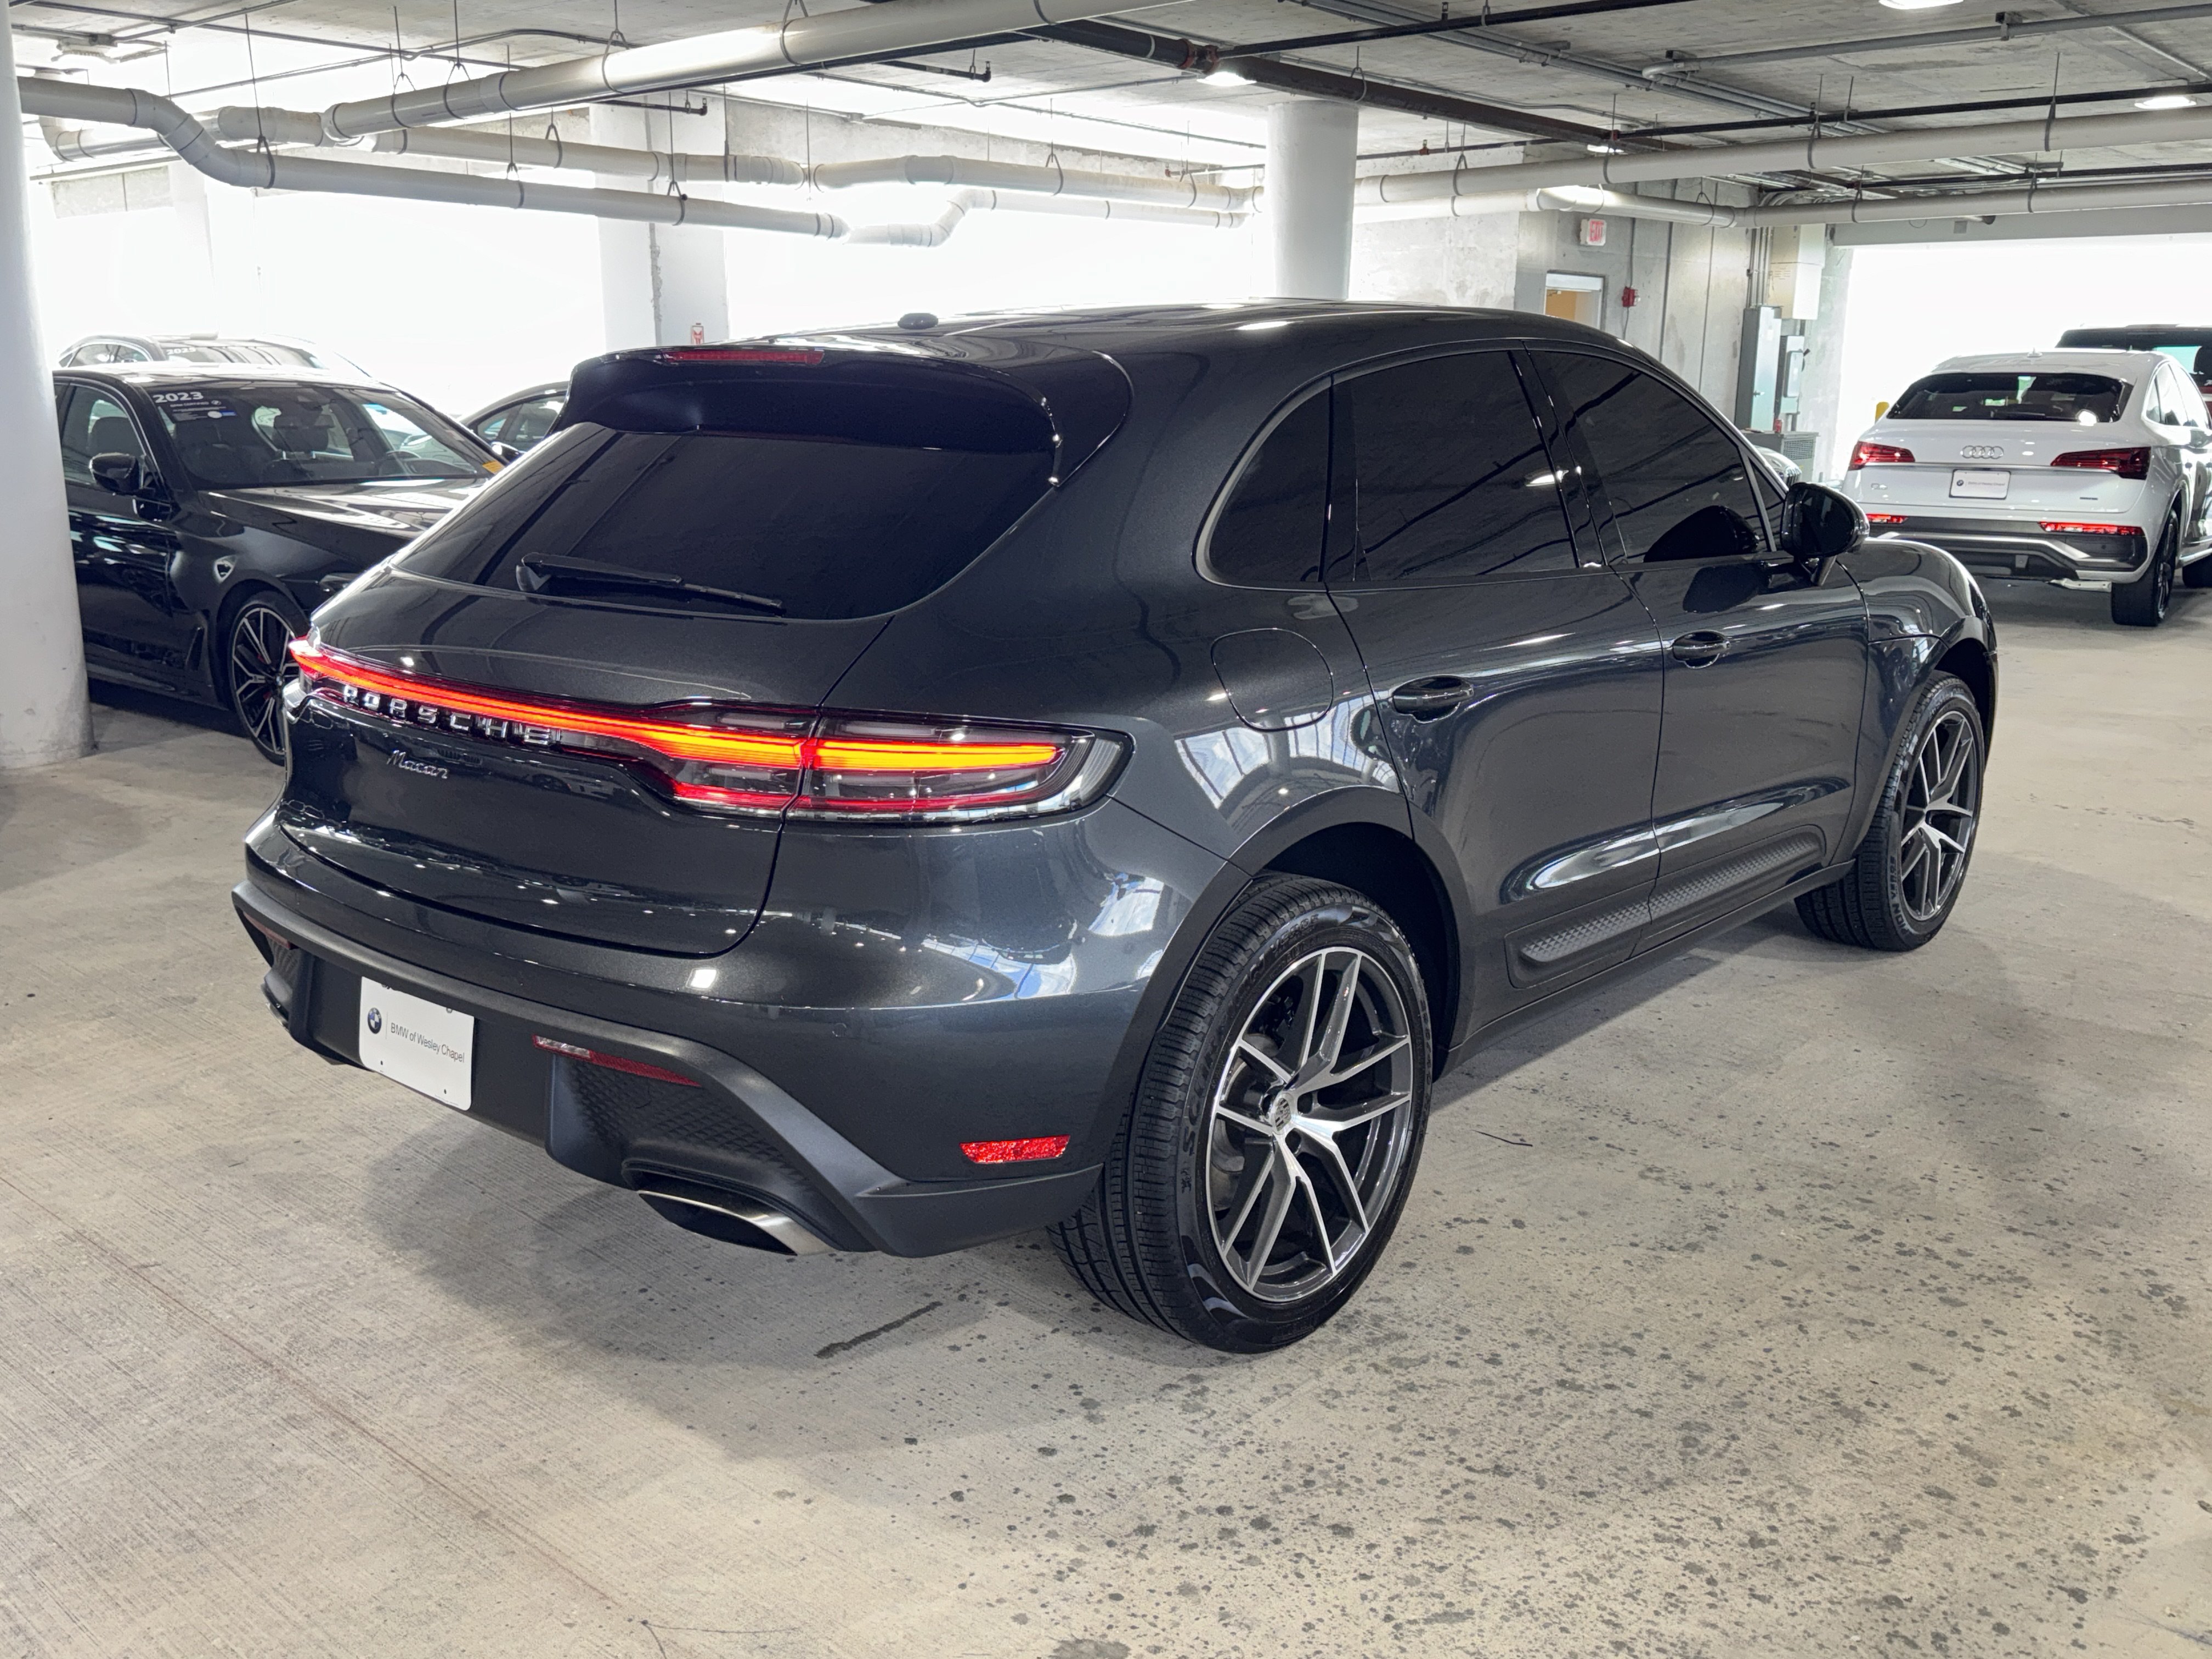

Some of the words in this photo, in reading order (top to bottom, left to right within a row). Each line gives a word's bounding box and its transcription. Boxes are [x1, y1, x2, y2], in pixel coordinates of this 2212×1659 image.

[153, 391, 204, 403] 2023
[343, 684, 550, 746] PORSCHE
[386, 750, 448, 779] Macan
[391, 1022, 409, 1039] BMW
[409, 1032, 416, 1042] of
[417, 1033, 441, 1054] Wesley
[441, 1044, 465, 1063] Chapel
